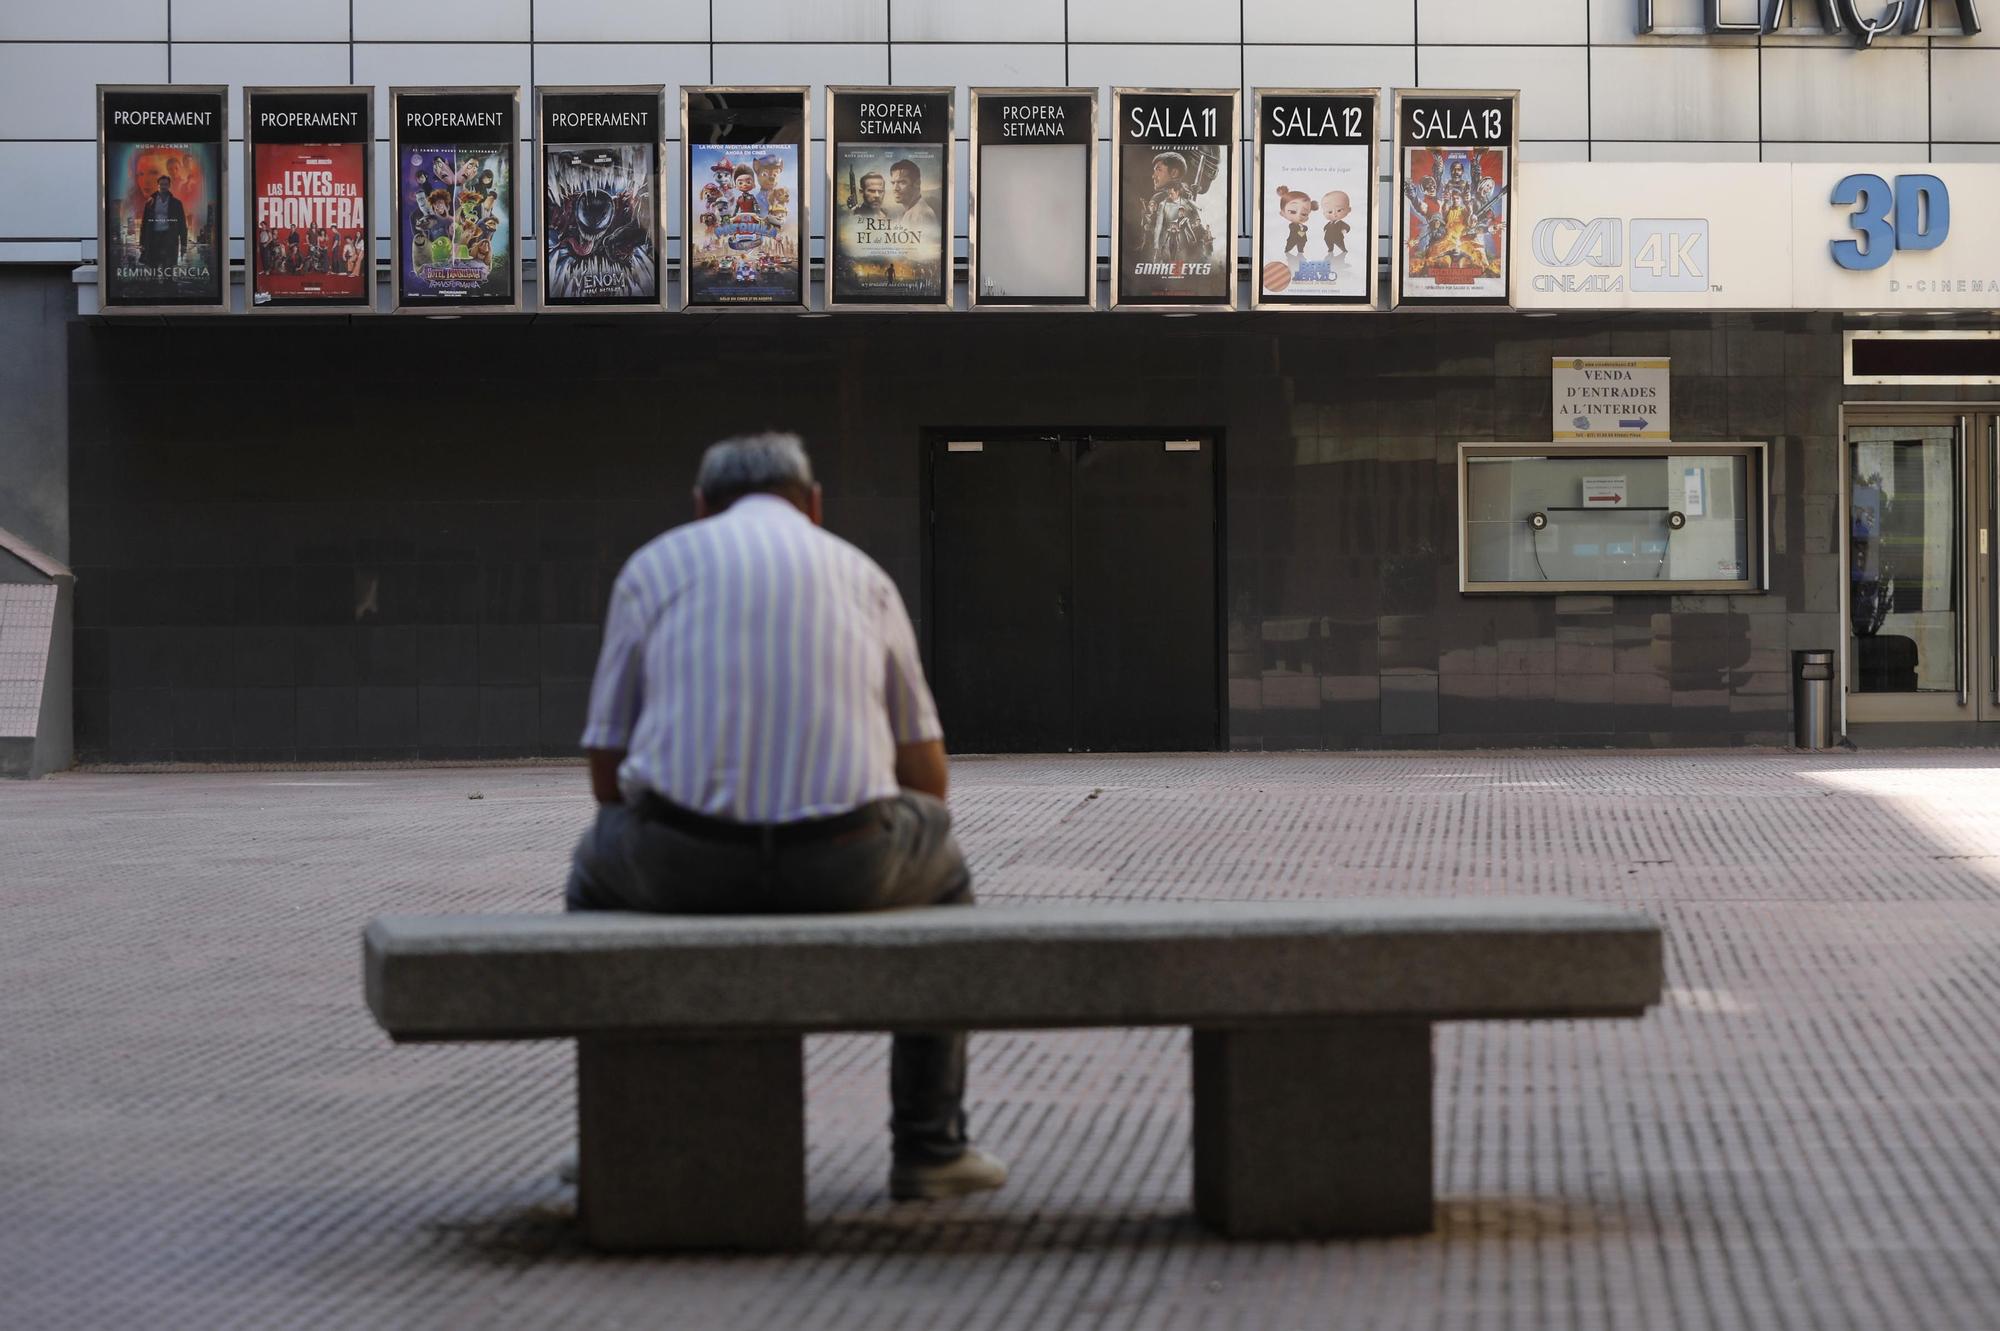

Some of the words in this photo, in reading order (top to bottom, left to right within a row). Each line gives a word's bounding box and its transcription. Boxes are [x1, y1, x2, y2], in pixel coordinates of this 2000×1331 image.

[114, 110, 212, 126] PROPERAMENT
[860, 103, 922, 118] PROPERA
[1003, 105, 1065, 120] PROPERA
[261, 112, 358, 127] PROPERAMENT
[407, 112, 503, 127] PROPERAMENT
[552, 112, 648, 127] PROPERAMENT
[1130, 106, 1198, 138] SALA
[1201, 107, 1217, 137] 11
[1271, 106, 1339, 137] SALA
[1342, 106, 1363, 137] 12
[1411, 108, 1479, 139] SALA
[1481, 108, 1502, 139] 13
[860, 120, 922, 135] SETMANA
[1003, 122, 1065, 137] SETMANA
[267, 183, 283, 197] LAS
[284, 170, 333, 197] LEYES
[334, 183, 345, 197] DE
[346, 183, 357, 197] LA
[258, 196, 365, 229] FRONTERA
[866, 218, 892, 231] REI
[1829, 173, 1951, 271] 3D
[857, 232, 872, 244] FI
[884, 228, 922, 244] MÓN
[1634, 232, 1704, 277] 4K
[116, 266, 210, 278] REMINISCENCIA
[1134, 262, 1177, 275] SNAKE
[1181, 262, 1212, 275] EYES
[572, 272, 626, 288] VENOM
[1531, 274, 1624, 292] CINEALTA
[1584, 370, 1632, 381] VENDA
[1560, 404, 1568, 415] A
